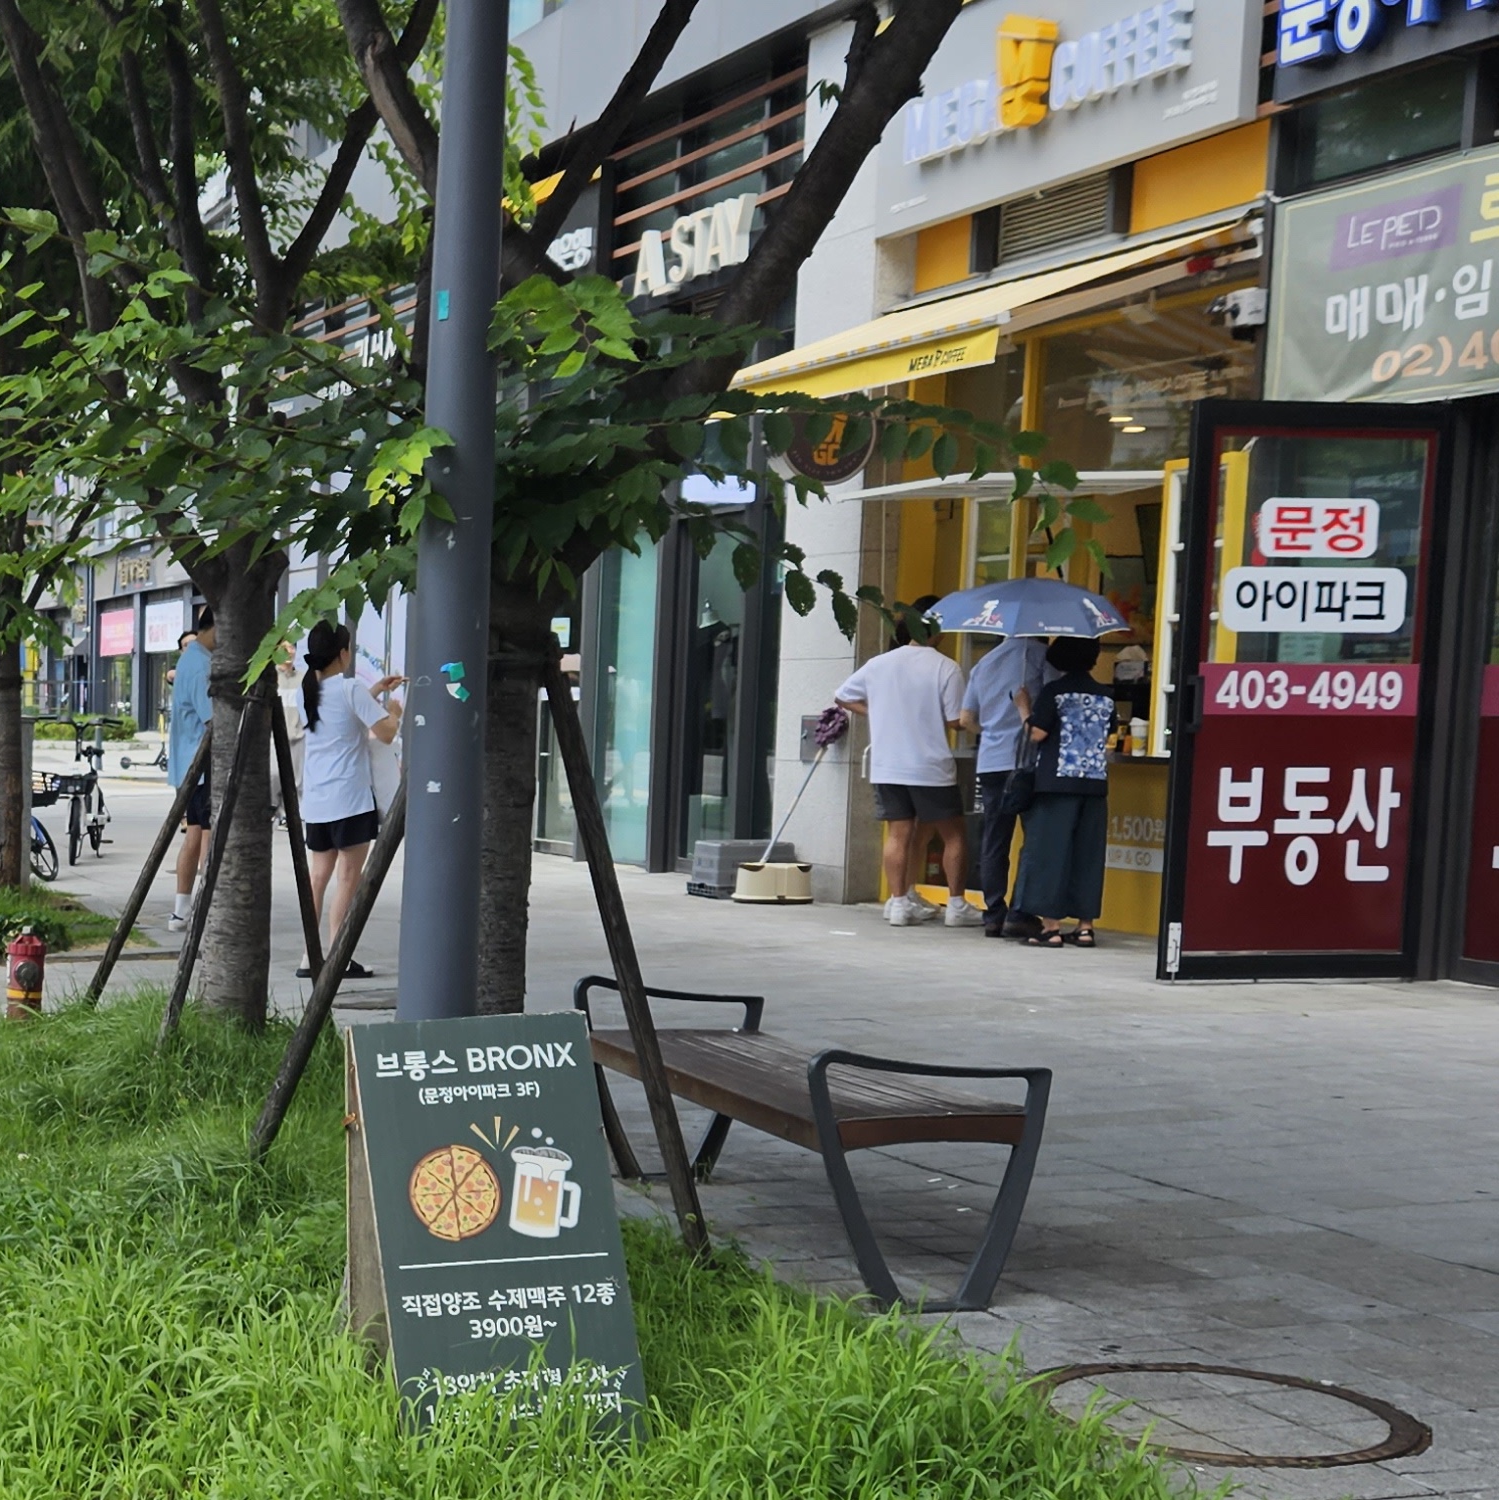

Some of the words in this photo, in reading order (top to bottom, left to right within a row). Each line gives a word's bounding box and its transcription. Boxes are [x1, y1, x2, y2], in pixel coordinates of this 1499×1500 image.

[633, 229, 681, 298] A
[668, 193, 758, 283] STAY
[1371, 329, 1499, 383] 02)4
[1269, 505, 1368, 552] 문정
[1236, 579, 1387, 623] 아이파크
[1215, 669, 1403, 710] 403-4949
[1207, 767, 1400, 886] 부동산
[376, 1050, 458, 1081] 브롱스
[466, 1042, 577, 1073] BRONX
[418, 1083, 511, 1106] (문정아이파크
[515, 1080, 541, 1099] 3F)
[402, 1291, 483, 1318] 직접양조
[488, 1285, 567, 1312] 수제맥주
[572, 1282, 616, 1306] 12종
